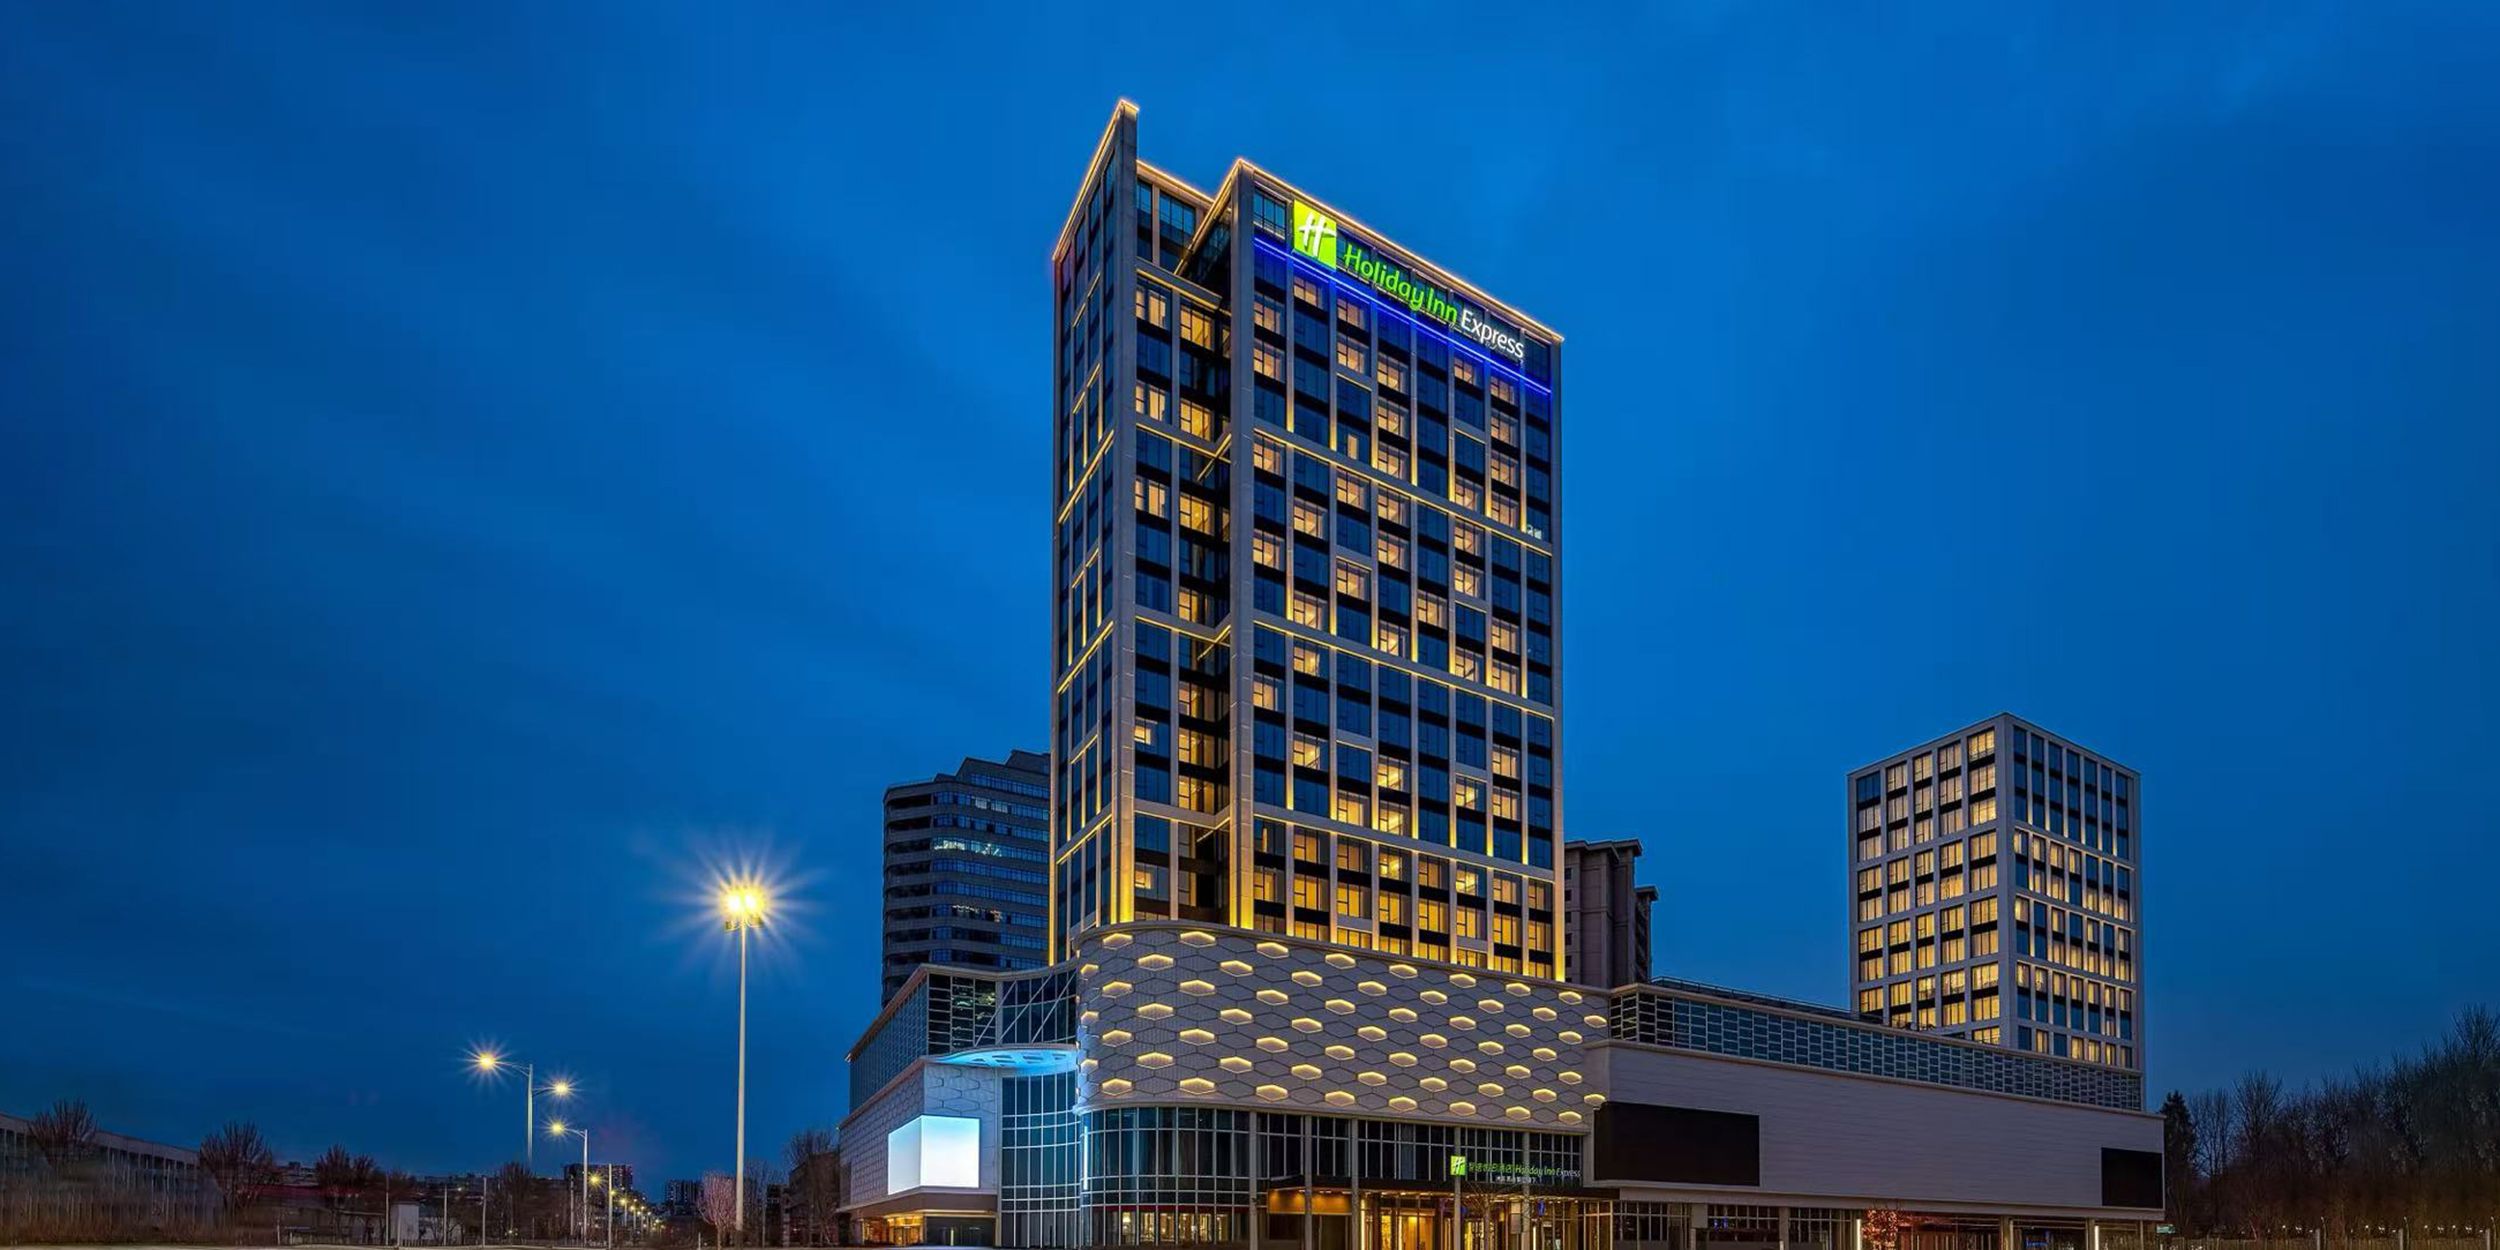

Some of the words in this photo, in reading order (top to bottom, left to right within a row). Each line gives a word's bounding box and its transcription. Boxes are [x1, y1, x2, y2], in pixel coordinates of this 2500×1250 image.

[1343, 243, 1424, 311] Holiday
[1426, 287, 1458, 325] Inn
[1461, 309, 1525, 359] Express
[1556, 1167, 1581, 1178] Express
